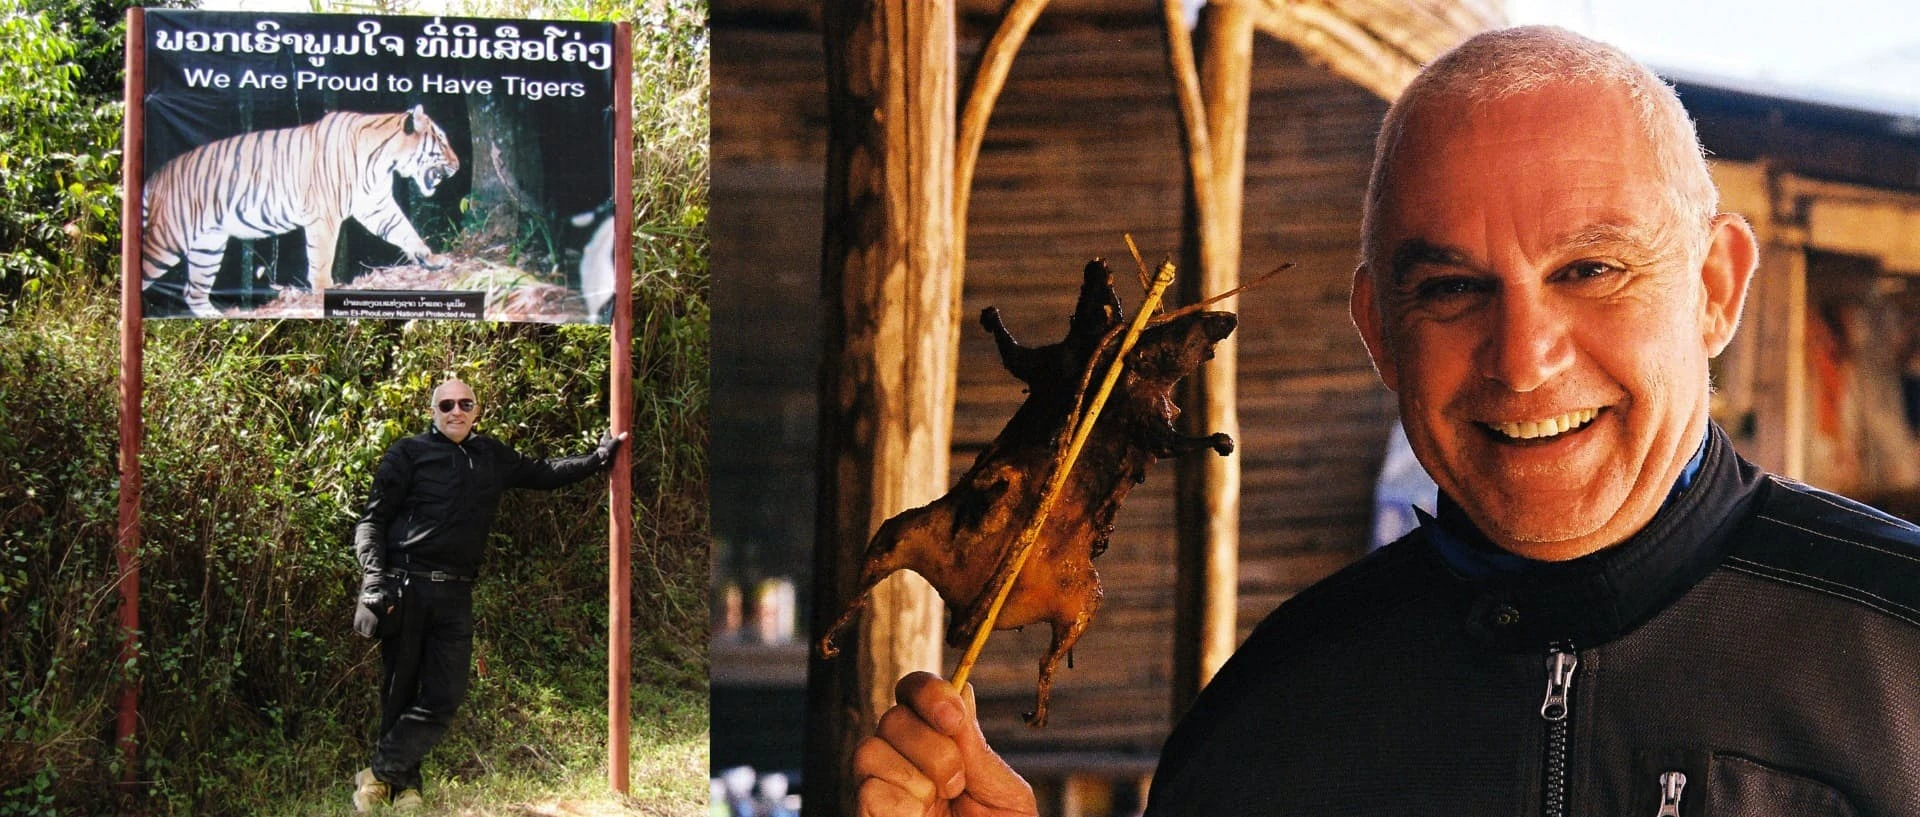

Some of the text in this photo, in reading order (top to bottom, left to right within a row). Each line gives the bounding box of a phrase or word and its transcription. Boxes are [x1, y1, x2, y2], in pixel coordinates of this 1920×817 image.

[183, 68, 586, 101] We Are Proud to Have Tigers
[332, 308, 350, 316] Nam
[425, 310, 459, 318] Protected
